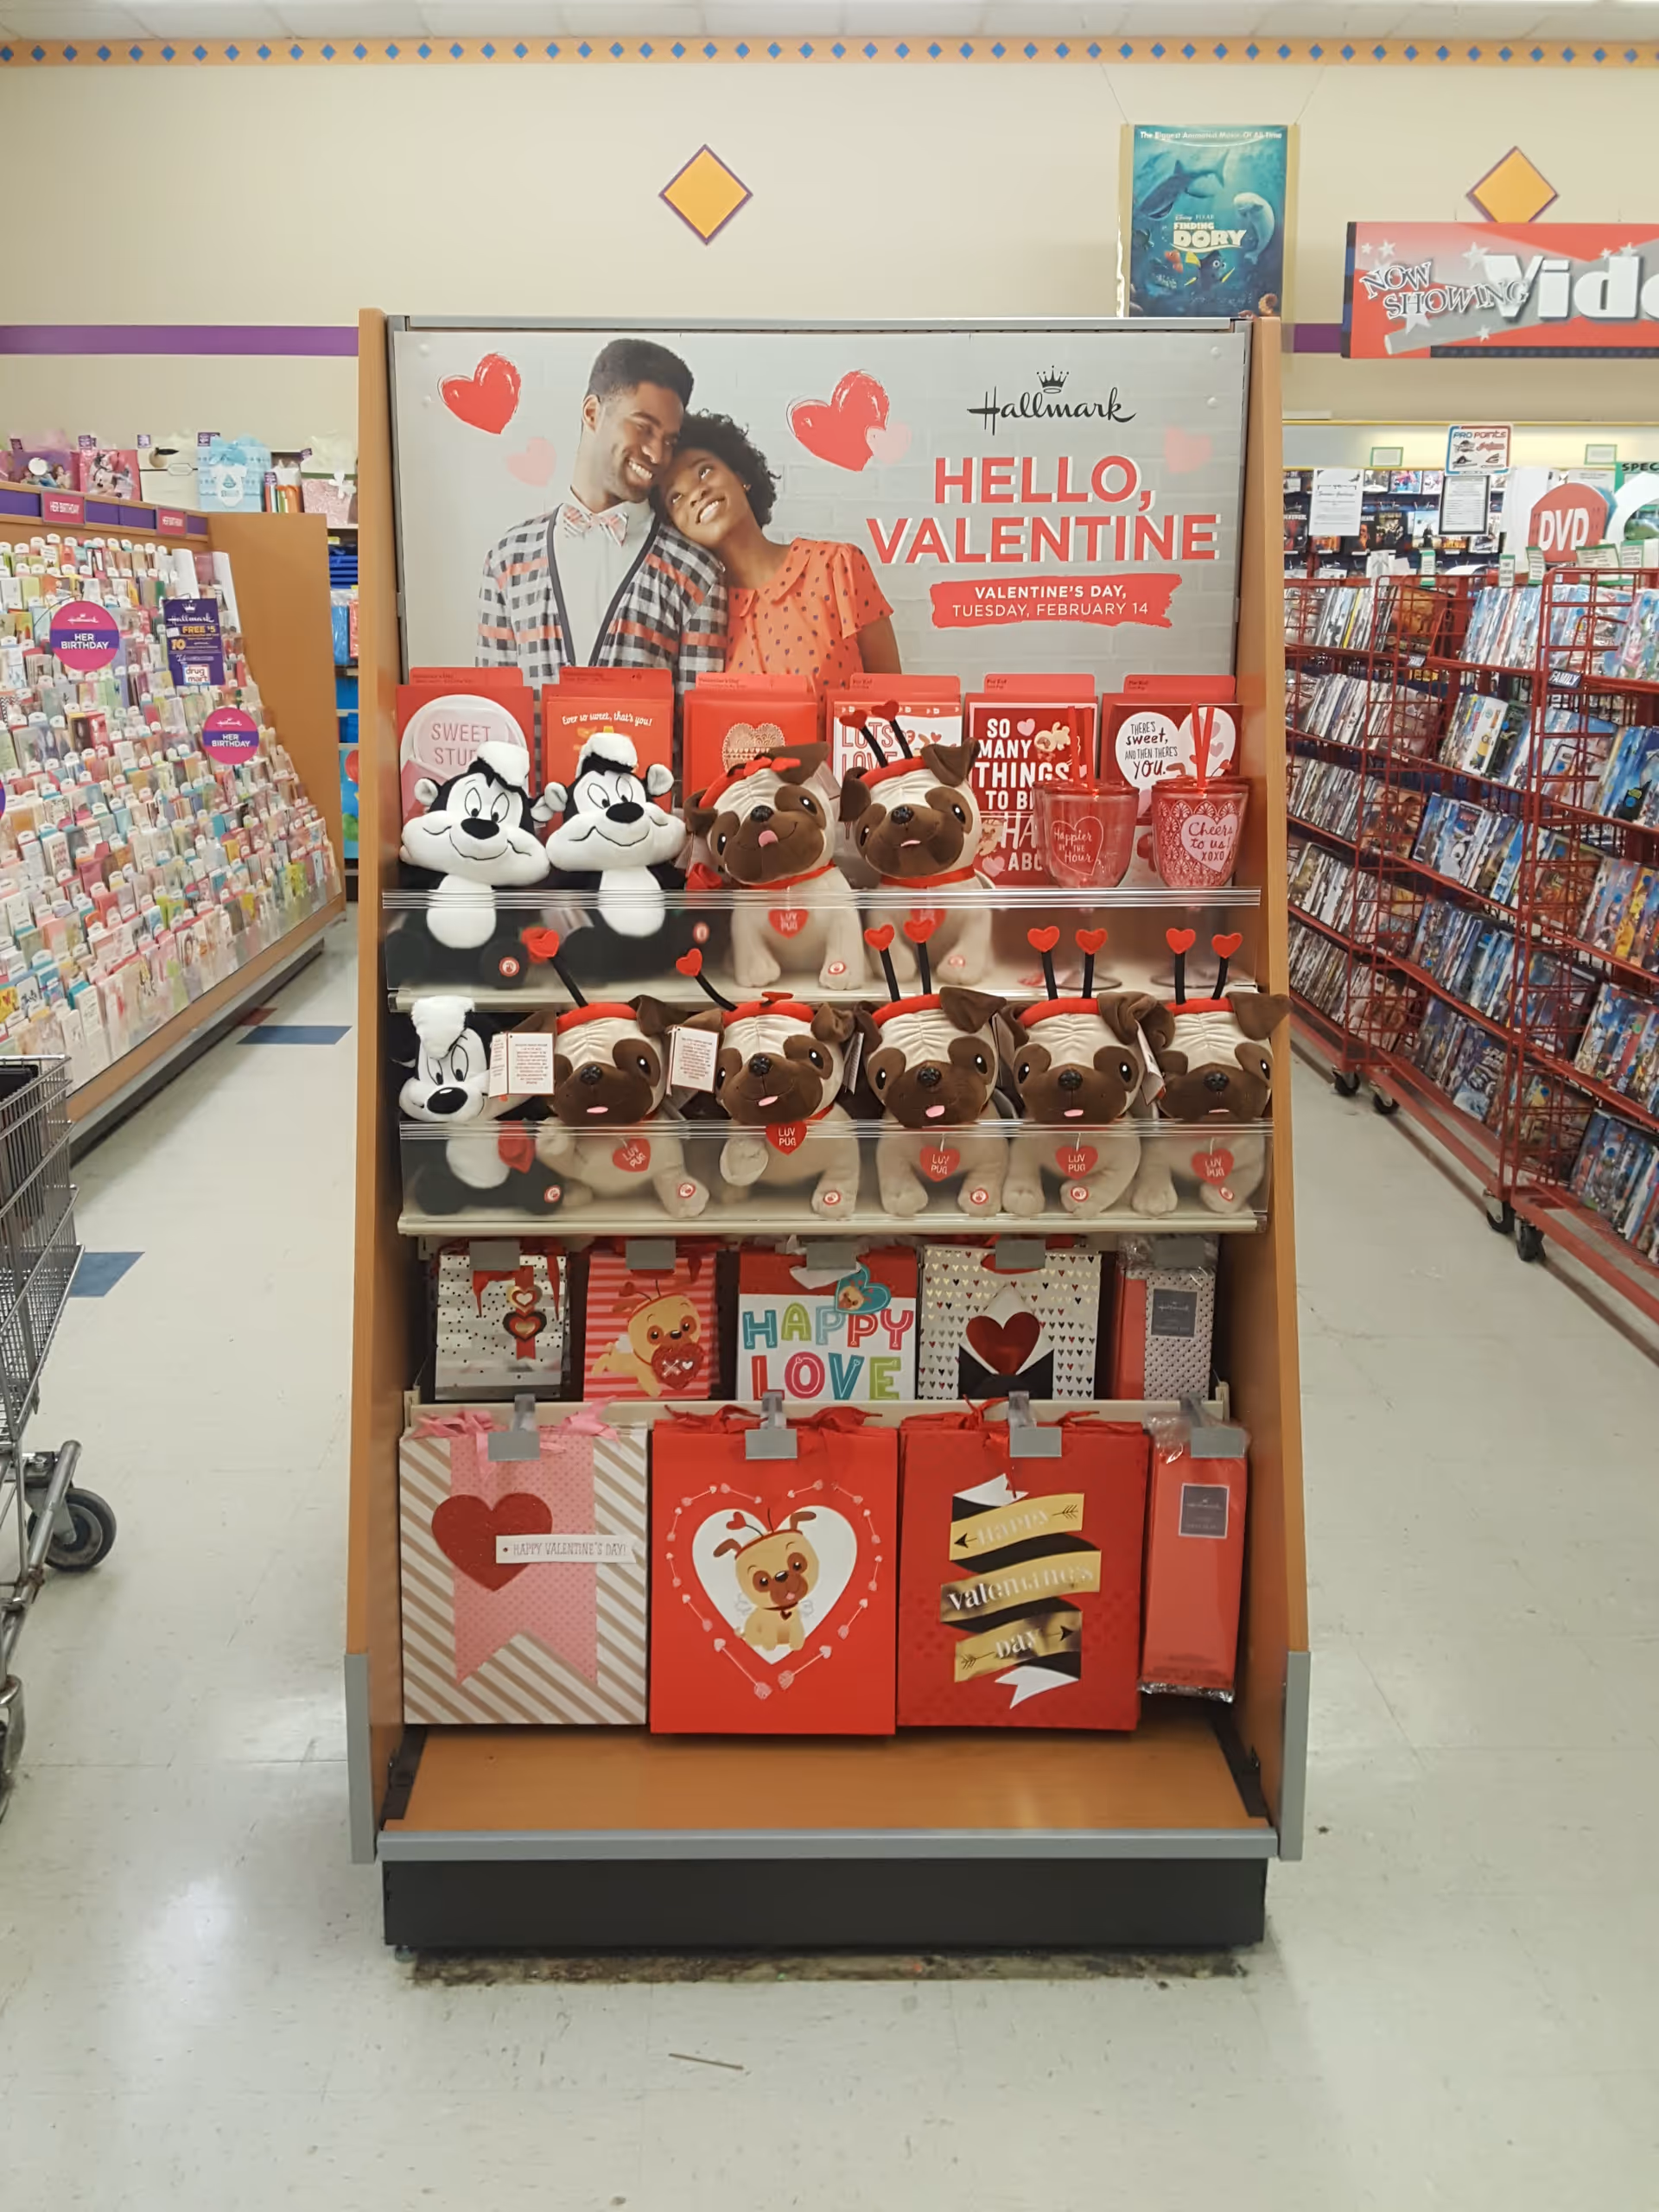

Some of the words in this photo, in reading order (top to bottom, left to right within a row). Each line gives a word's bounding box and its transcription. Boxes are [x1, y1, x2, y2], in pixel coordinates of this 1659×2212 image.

[1173, 230, 1247, 249] DORY
[1359, 262, 1432, 300] NOW
[1383, 279, 1529, 321] SHOWING
[966, 385, 1137, 435] Hallmark
[935, 455, 1156, 512] HELLO,
[1538, 507, 1589, 551] DVD
[867, 514, 1222, 564] VALENTINE
[975, 586, 1084, 600] VALENTINE'S
[1090, 585, 1127, 599] DAY,
[952, 604, 1030, 618] TUESDAY,
[1037, 602, 1127, 616] FEBRUARY
[1133, 602, 1148, 614] 14
[167, 613, 214, 626] Hallmark
[61, 641, 109, 650] BIRTHDAY
[171, 639, 186, 651] 10
[563, 715, 578, 726] Ever
[580, 714, 588, 722] so
[589, 712, 612, 722] sweet,
[613, 710, 633, 723] that's
[635, 716, 652, 727] you!
[432, 723, 491, 742] SWEET
[987, 718, 1010, 739] SO
[1130, 721, 1156, 735] THERE'S
[1125, 727, 1168, 747] sweet,
[435, 747, 478, 766] STU
[977, 740, 1032, 759] MANY
[1125, 749, 1136, 760] AND
[1137, 747, 1153, 760] THEN
[1154, 746, 1179, 759] THERE'S
[974, 761, 1071, 788] THINGS
[985, 791, 1008, 810] TO
[1054, 827, 1093, 847] Happier
[1189, 822, 1233, 836] Cheers
[1191, 838, 1205, 849] to
[1211, 836, 1230, 849] us!
[1065, 850, 1094, 863] Hour
[1201, 851, 1224, 861] XOXO
[779, 1127, 796, 1137] LUV
[779, 1137, 797, 1147] PUG
[621, 1143, 639, 1161] LUV
[932, 1154, 950, 1165] LUV
[1068, 1154, 1086, 1163] LUV
[630, 1153, 646, 1169] PUG
[1068, 1163, 1086, 1173] PUG
[931, 1164, 948, 1175] PUG
[742, 1302, 914, 1350] HAPPY
[752, 1351, 901, 1401] LOVE
[513, 1542, 542, 1555] HAPPY
[545, 1541, 602, 1555] VALENTINE'S
[606, 1543, 626, 1555] DAY!
